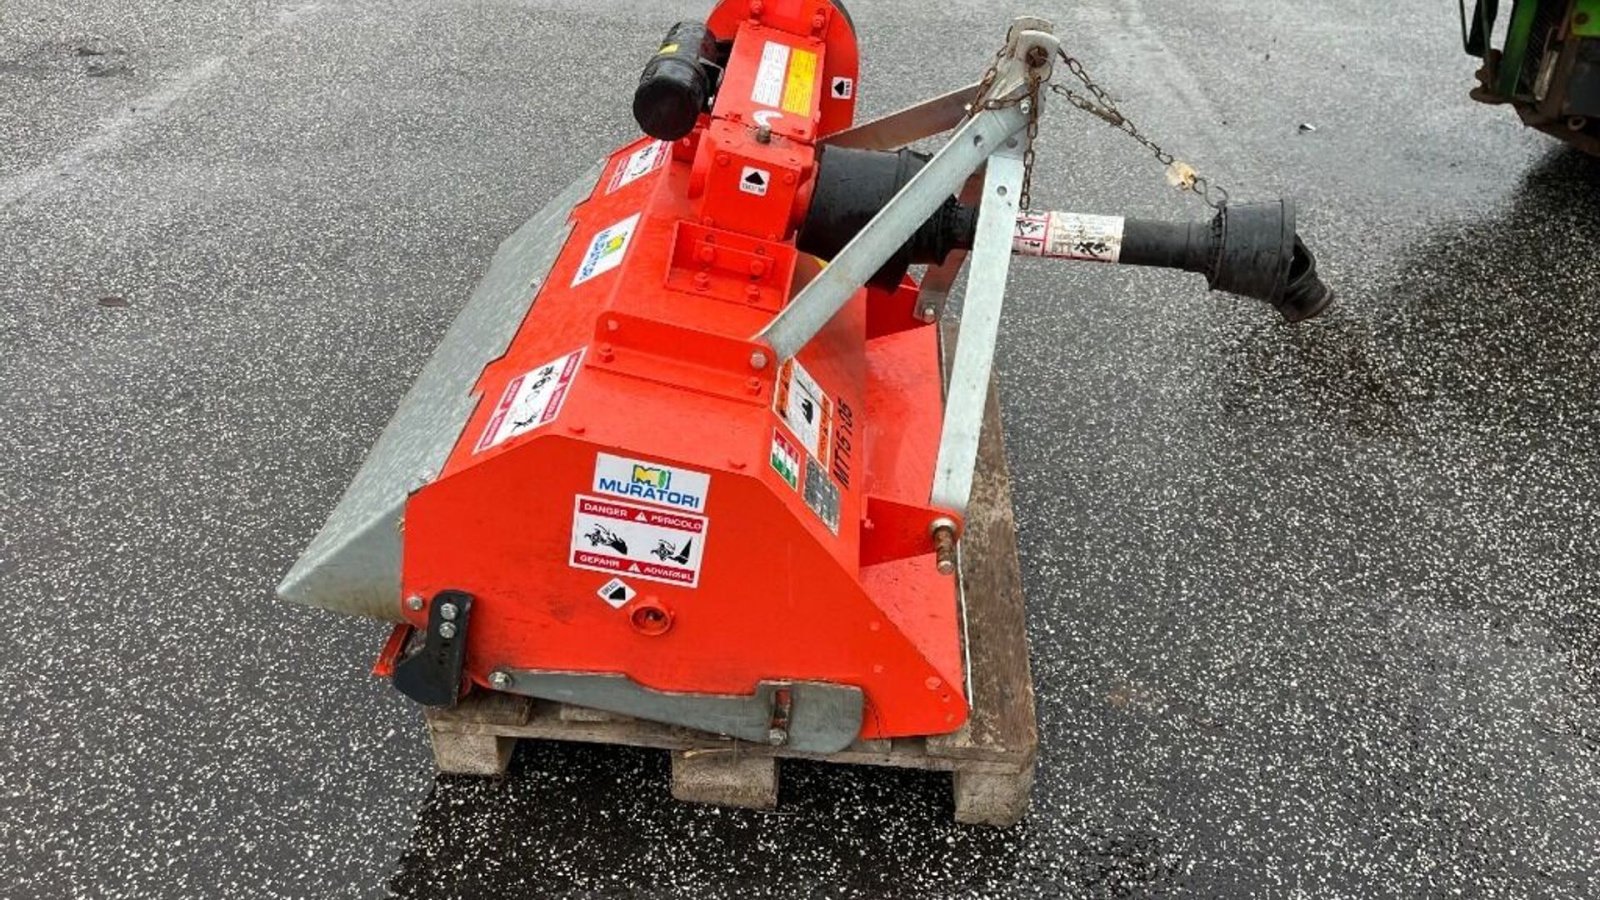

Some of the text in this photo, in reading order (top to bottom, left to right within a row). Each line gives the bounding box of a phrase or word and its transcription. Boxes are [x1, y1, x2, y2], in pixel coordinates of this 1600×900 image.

[599, 478, 700, 509] MURATORI
[584, 502, 702, 531] DANGER PERICOLO
[579, 554, 693, 581] GEFAHR ADVARSEL
